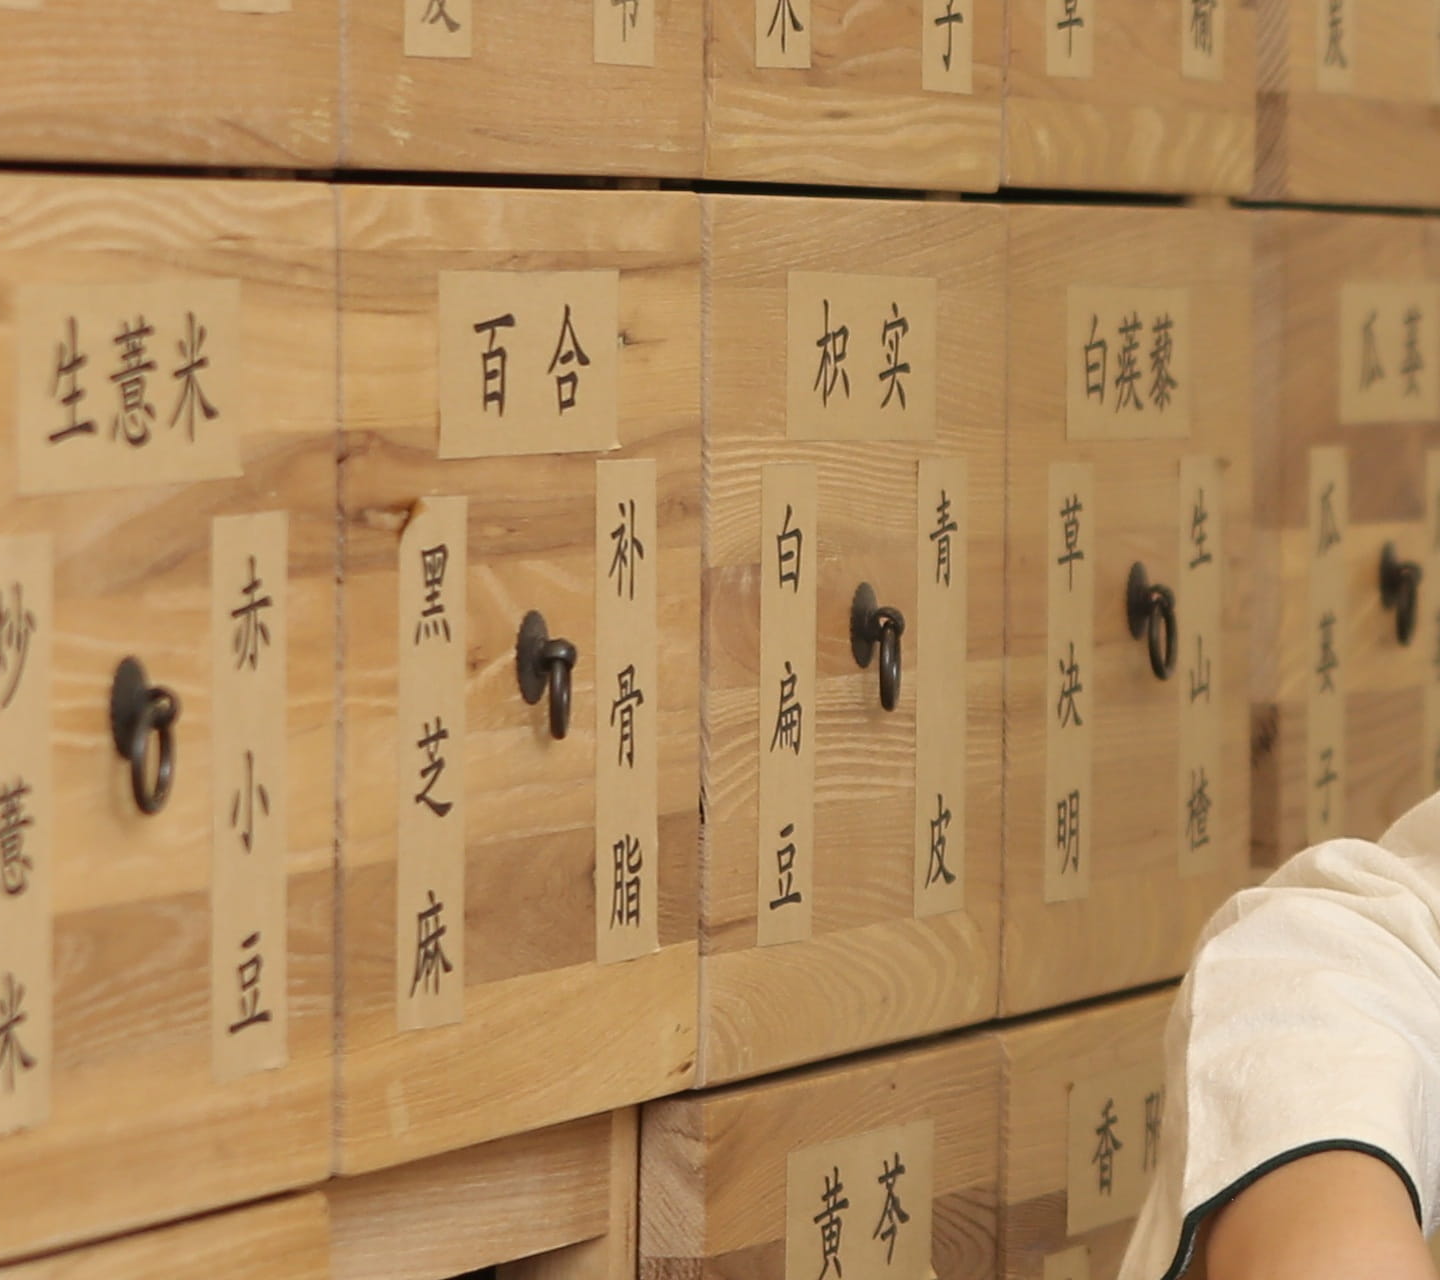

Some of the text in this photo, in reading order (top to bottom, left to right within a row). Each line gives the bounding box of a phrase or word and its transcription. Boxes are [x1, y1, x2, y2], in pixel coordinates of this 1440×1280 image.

[48, 312, 218, 448] 生薏米
[473, 305, 590, 416] 百合
[814, 299, 910, 409] 枳实
[228, 556, 272, 1034] 赤小豆
[410, 544, 452, 997] 黑芝麻
[609, 500, 644, 928] 补骨脂
[769, 504, 802, 910] 白扁豆
[925, 490, 957, 888] 青皮
[1057, 494, 1084, 874] 草决明
